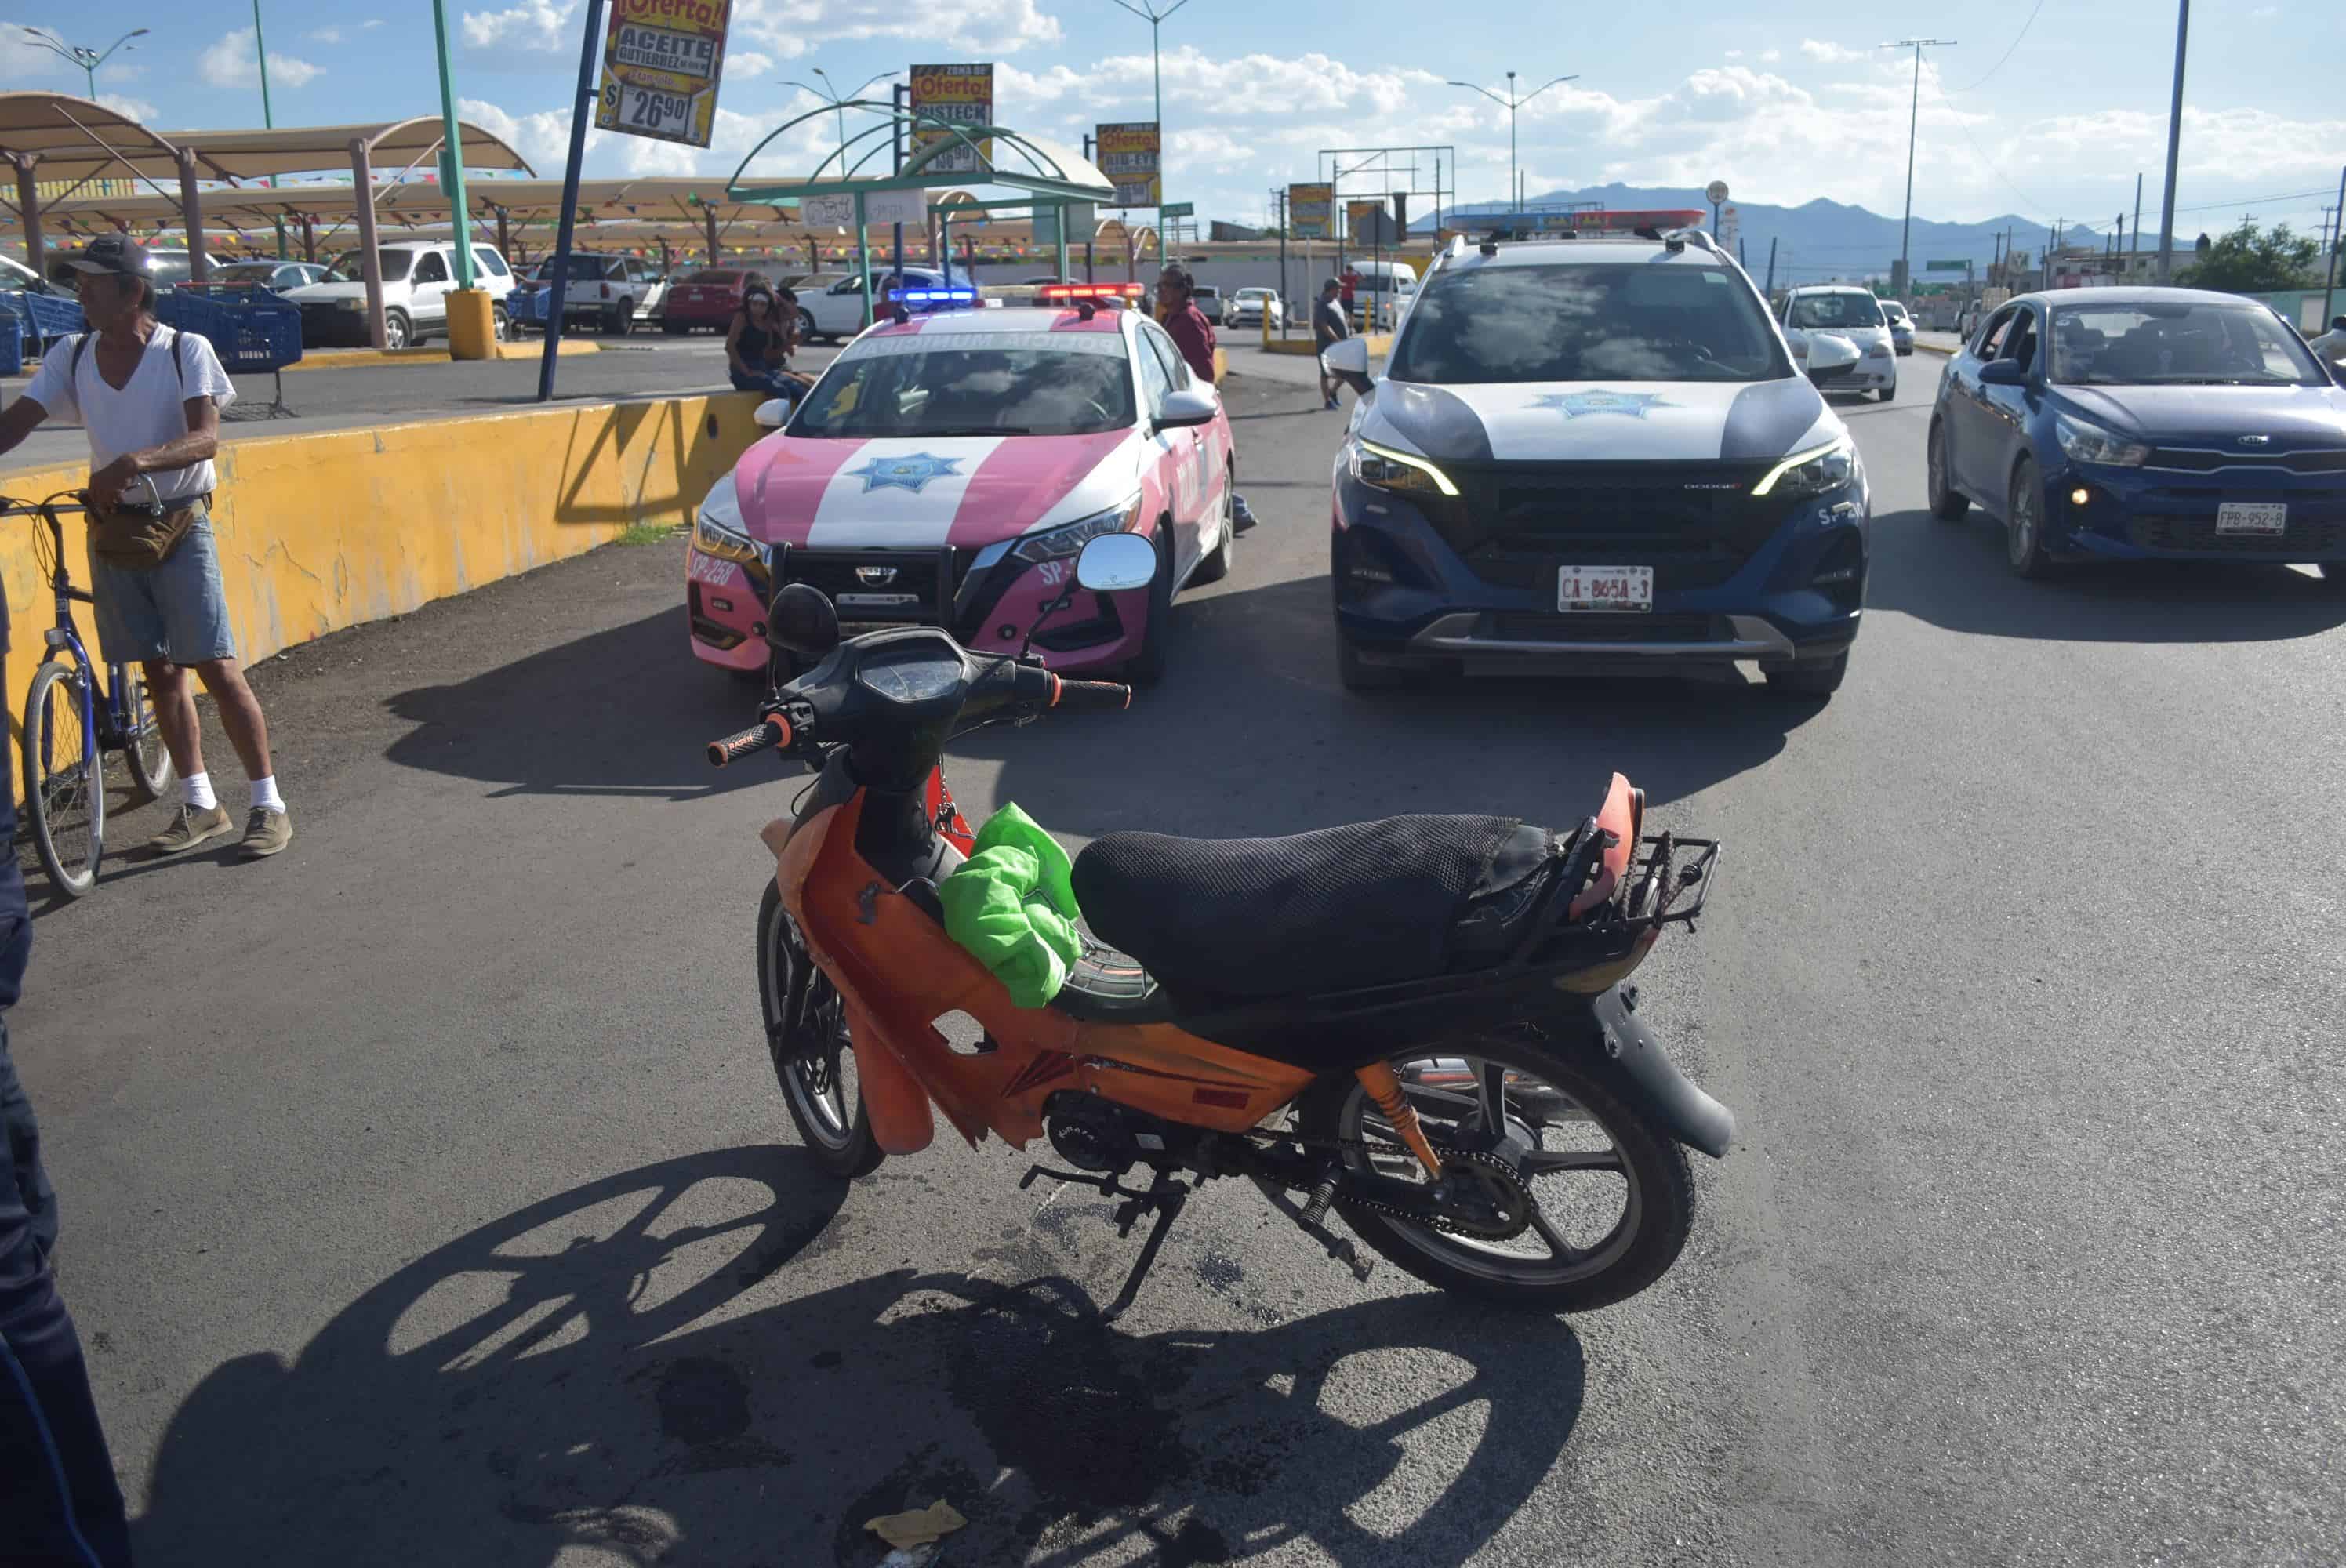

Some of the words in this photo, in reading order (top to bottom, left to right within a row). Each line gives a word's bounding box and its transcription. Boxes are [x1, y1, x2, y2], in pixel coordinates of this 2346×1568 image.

[620, 27, 711, 59] ACEITE
[619, 46, 679, 69] GUTIERREZ
[605, 83, 617, 107] $
[690, 554, 736, 586] SP-258
